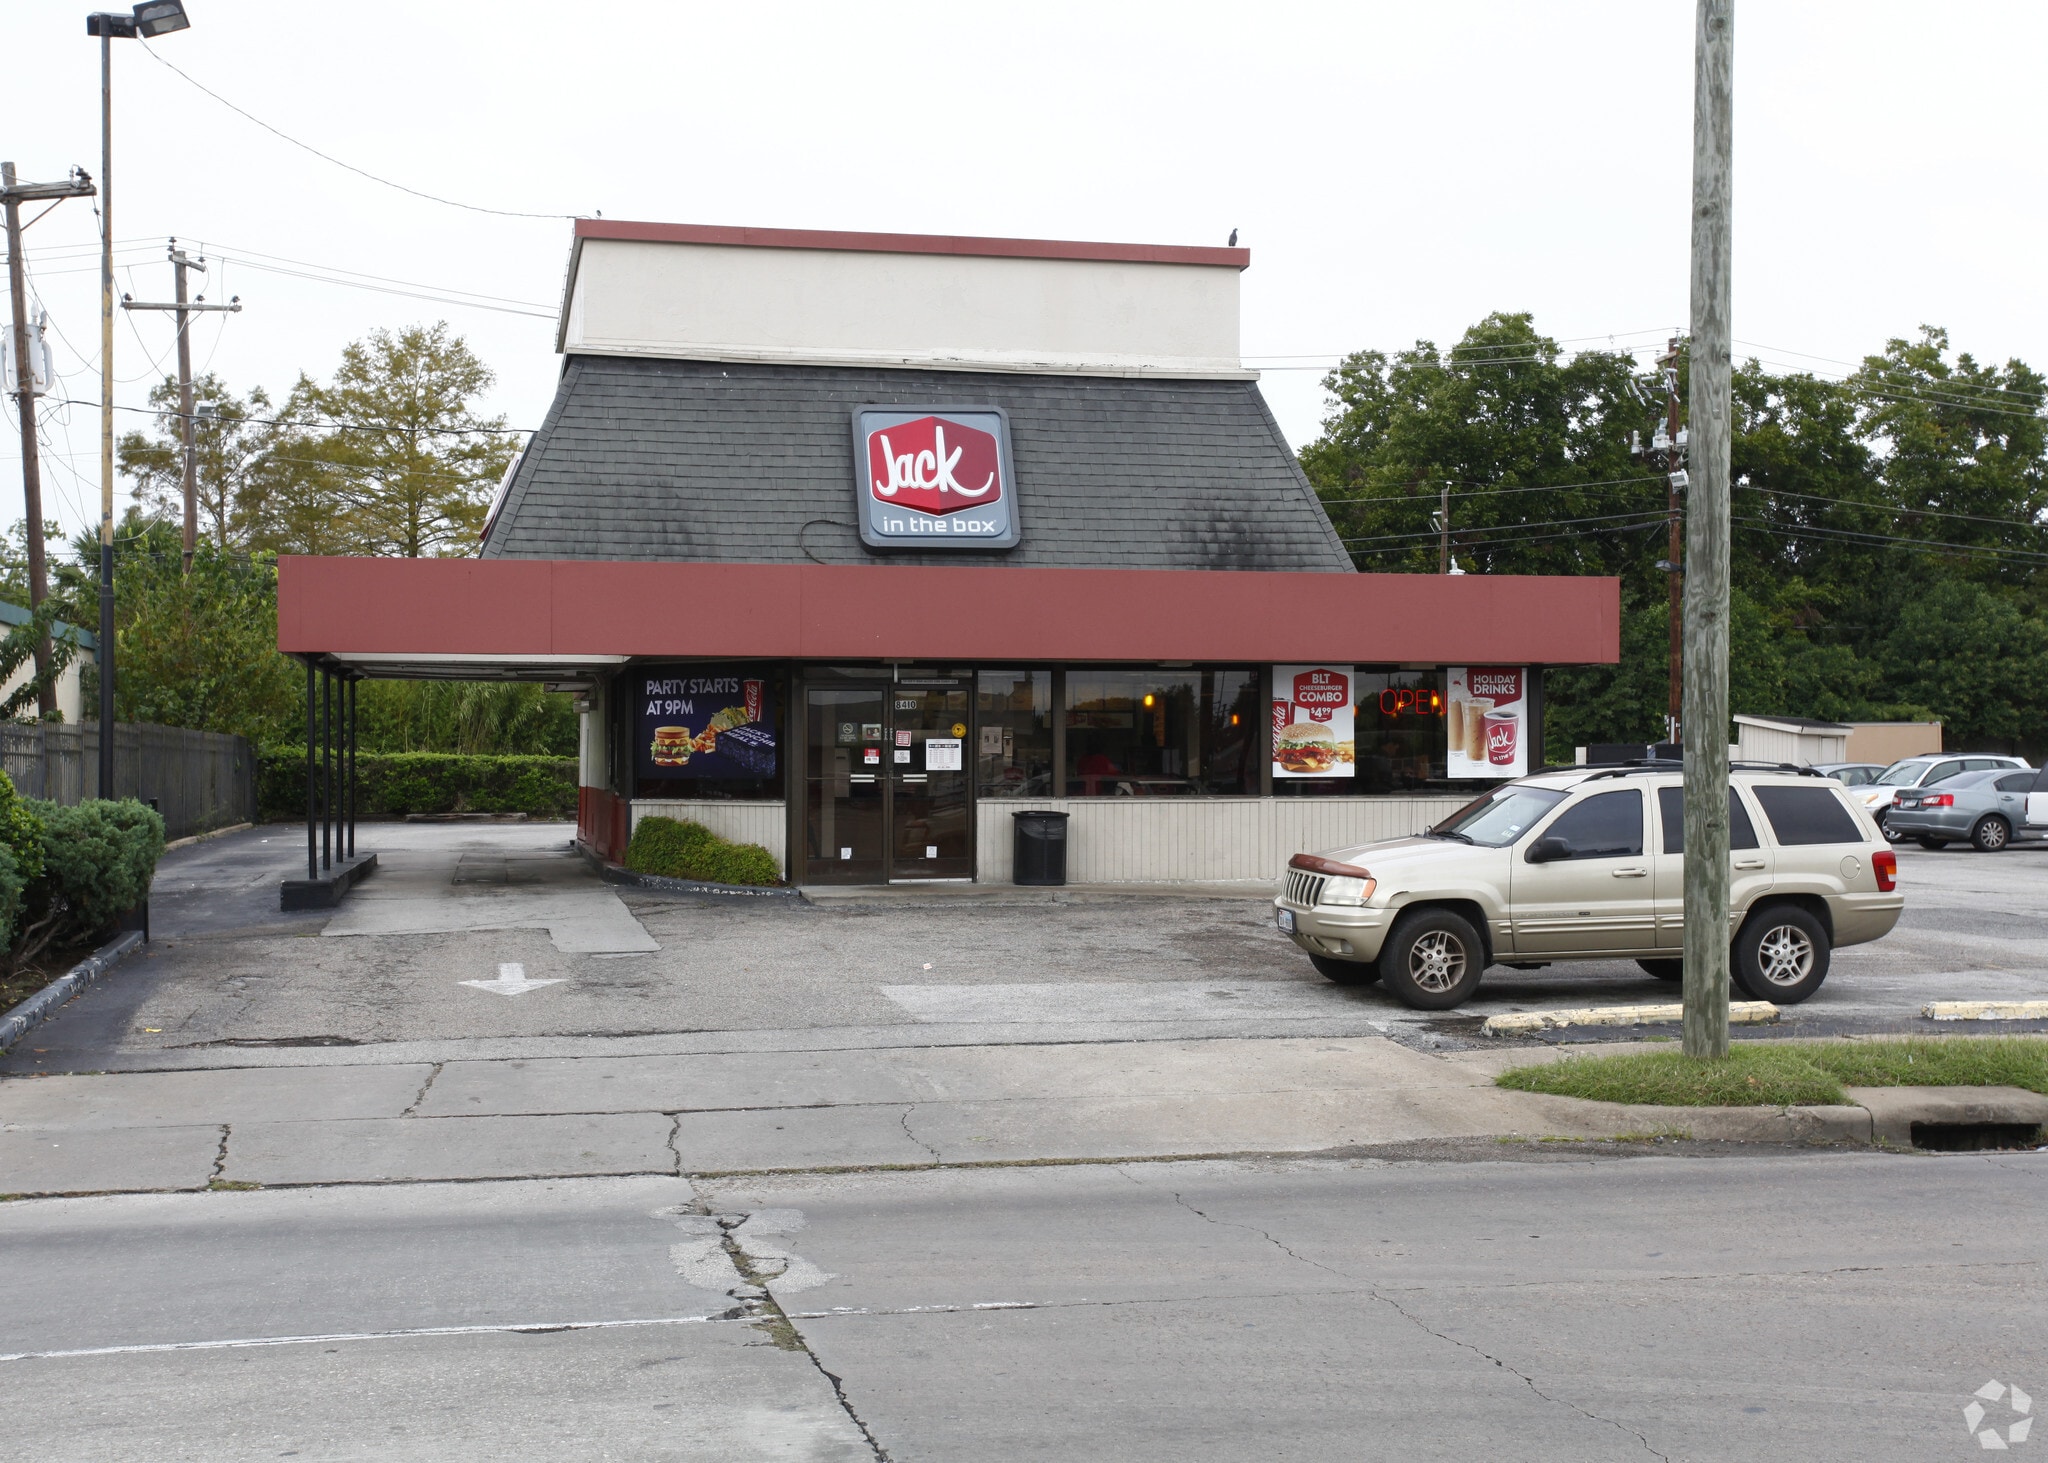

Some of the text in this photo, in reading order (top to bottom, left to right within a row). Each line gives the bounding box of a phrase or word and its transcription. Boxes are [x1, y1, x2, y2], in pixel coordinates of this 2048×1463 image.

[876, 425, 994, 497] Jack
[883, 516, 995, 533] in the box
[646, 677, 739, 695] PARTY STARTS
[1311, 674, 1331, 684] BLT
[1473, 675, 1516, 684] HOLIDAY
[1299, 692, 1343, 702] COMBO
[1473, 683, 1515, 695] DRINKS
[646, 699, 694, 715] AT 9PM
[895, 700, 916, 709] 8410
[1379, 689, 1447, 715] OPEN
[1488, 727, 1514, 749] Jack
